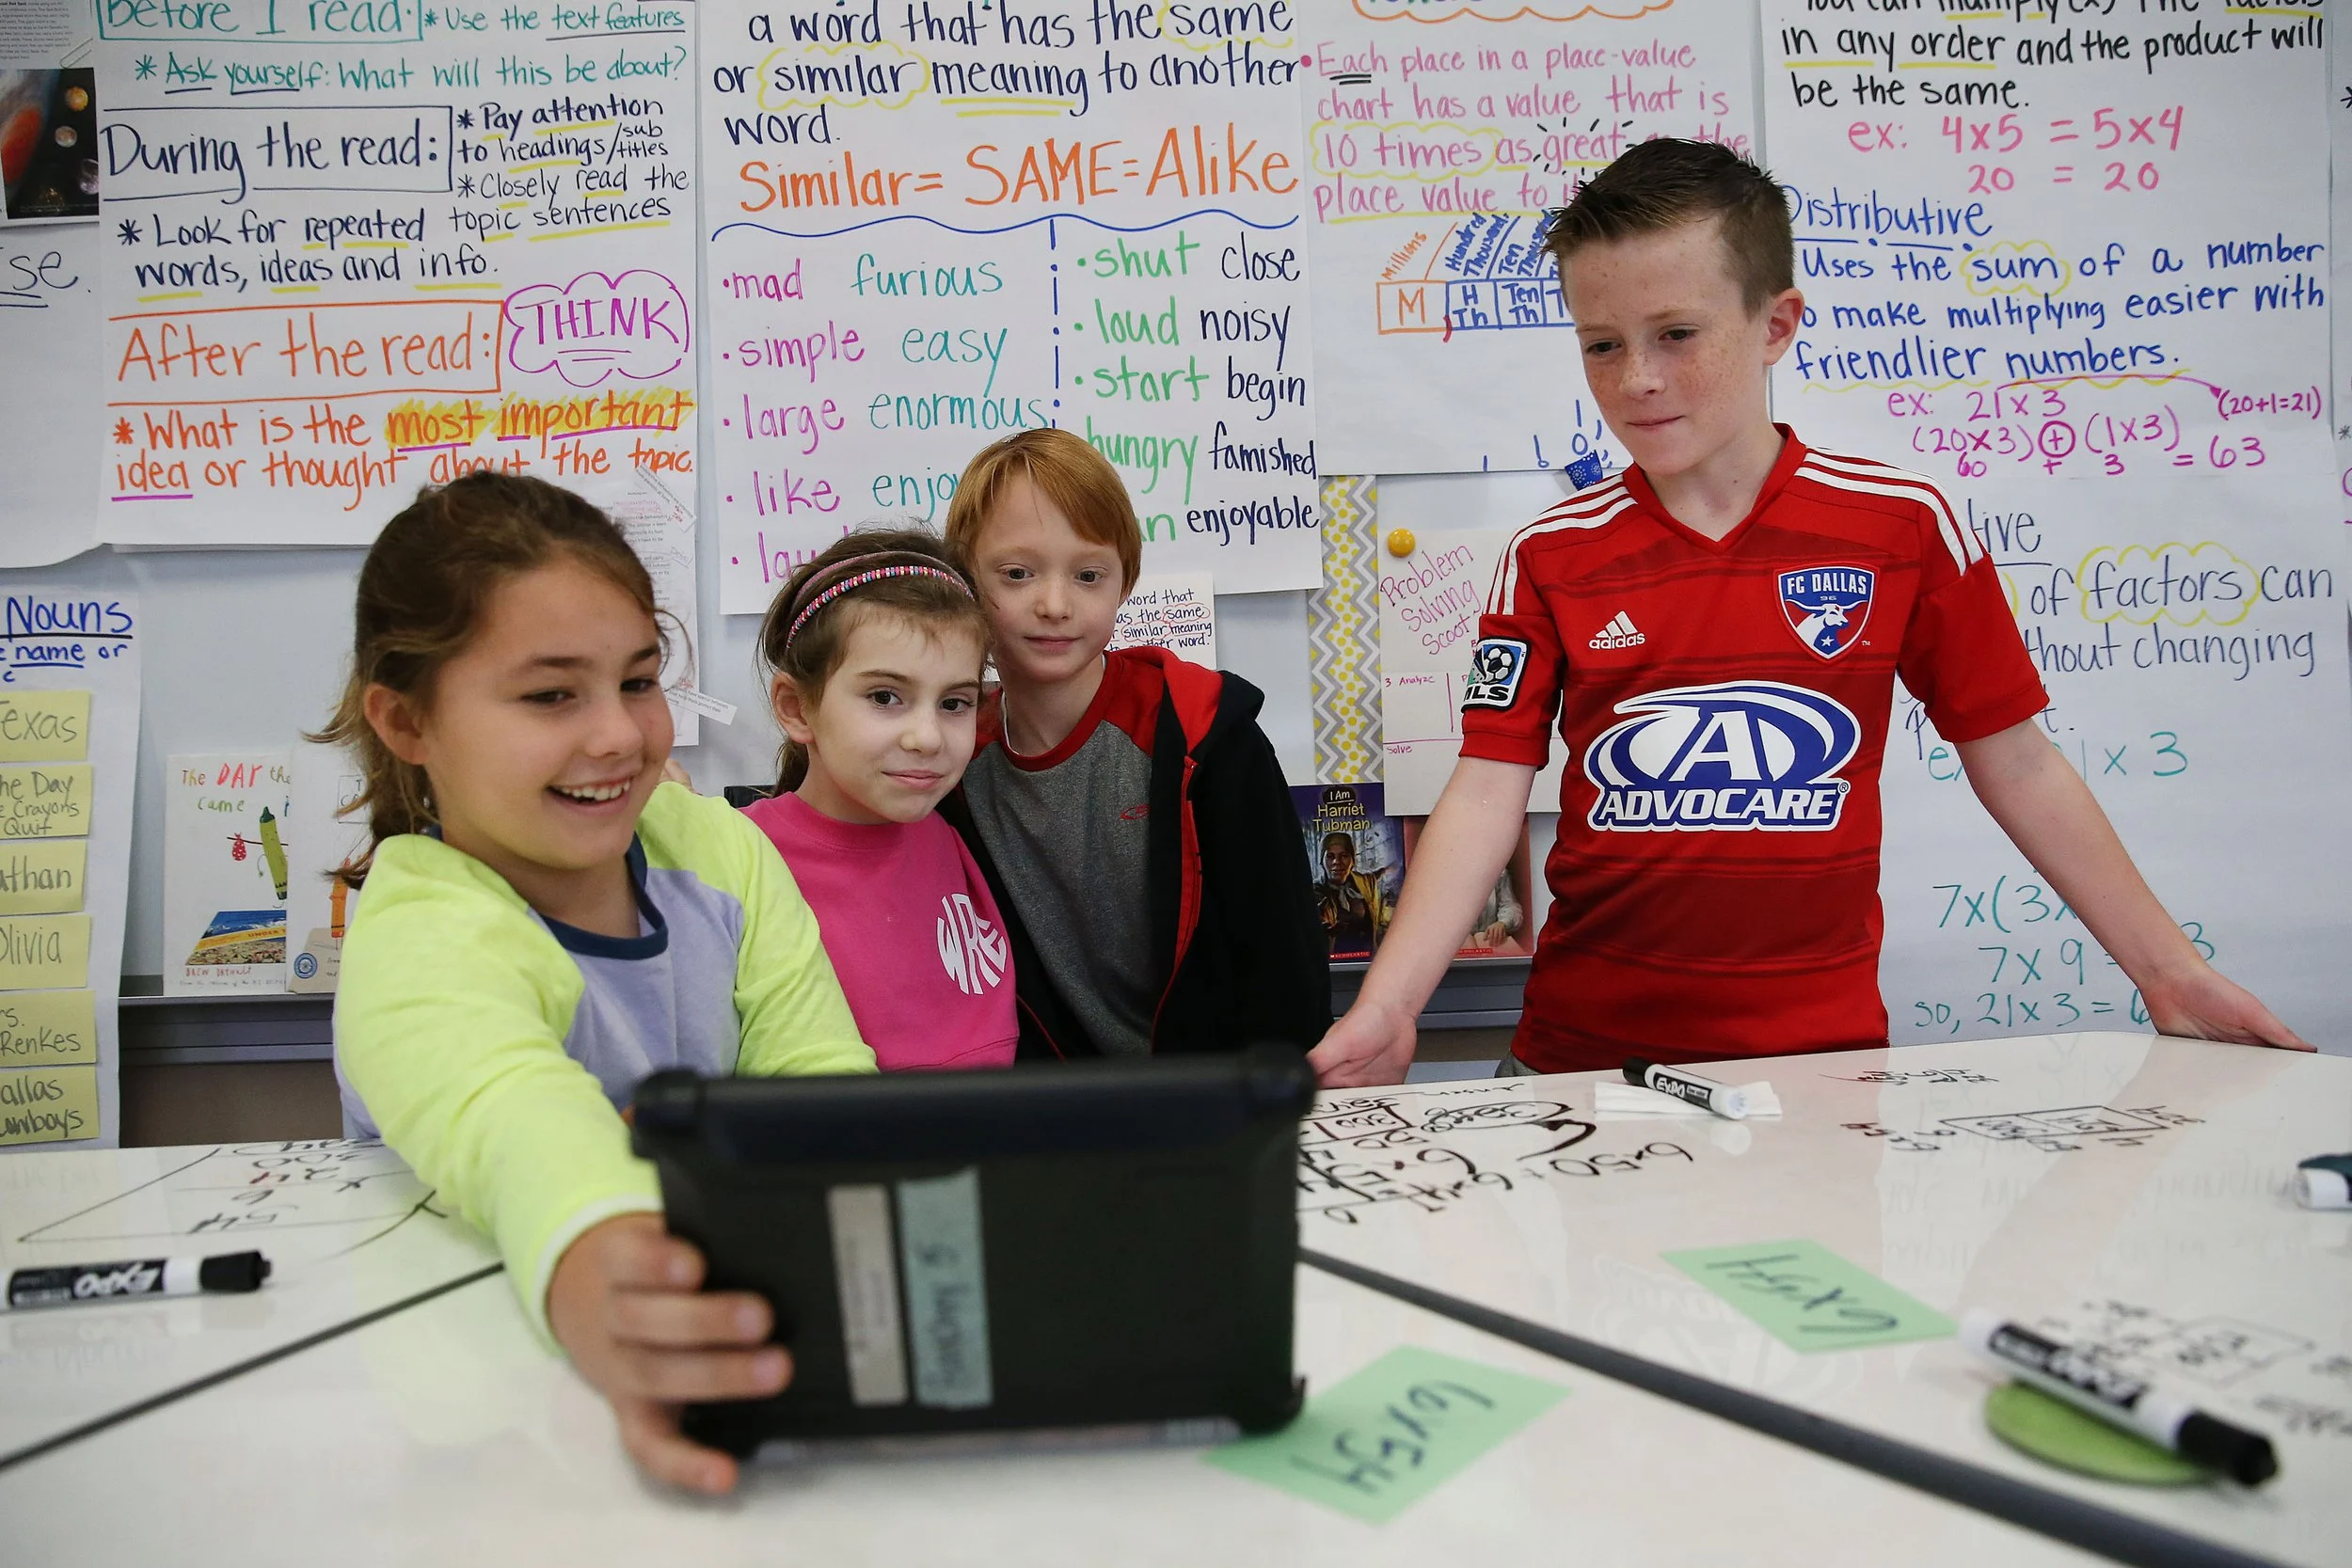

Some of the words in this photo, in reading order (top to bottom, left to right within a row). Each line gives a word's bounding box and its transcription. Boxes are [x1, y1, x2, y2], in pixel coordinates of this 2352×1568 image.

[445, 5, 487, 31] Use
[500, 7, 535, 29] the
[551, 4, 599, 28] text
[606, 2, 685, 28] features
[790, 3, 882, 44] word
[900, 2, 978, 43] that
[1000, 0, 1075, 48] has
[1162, 0, 1294, 40] same
[1317, 41, 1389, 77] Each
[1402, 46, 1465, 83] place
[1546, 39, 1696, 80] place-value
[1837, 29, 1895, 72] any
[1911, 25, 2006, 62] order
[2017, 27, 2074, 66] and
[2144, 15, 2263, 74] product
[2270, 17, 2324, 51] will
[166, 51, 213, 85] Ask
[231, 54, 330, 92] yourself:
[435, 53, 480, 87] will
[497, 54, 553, 86] this
[608, 46, 687, 81] about?
[774, 55, 919, 98] similar
[932, 58, 1089, 117] meaning
[1149, 42, 1302, 87] another
[1851, 73, 1905, 106] the
[1920, 81, 2030, 108] same.
[1318, 87, 1394, 121] chart
[1413, 83, 1466, 119] has
[1505, 84, 1581, 117] value
[1606, 73, 1683, 115] that
[484, 104, 523, 140] Pay
[533, 99, 663, 125] attention
[724, 110, 841, 148] word.
[1849, 123, 1907, 152] ex:
[103, 124, 246, 203] During
[264, 119, 329, 169] the
[341, 119, 438, 167] read:
[1323, 134, 1357, 168] 10
[1374, 135, 1482, 168] times
[1542, 124, 1628, 175] great
[481, 172, 559, 208] Closely
[576, 167, 628, 193] read
[644, 167, 690, 191] the
[1313, 173, 1405, 224] place
[1422, 176, 1500, 213] value
[1967, 164, 2014, 194] 20
[2104, 162, 2160, 191] 20
[153, 212, 230, 245] Look
[240, 212, 286, 245] for
[304, 209, 426, 251] repeated
[450, 204, 516, 237] topic
[530, 198, 671, 227] sentences
[136, 250, 246, 290] words,
[262, 250, 334, 284] ideas
[420, 248, 498, 277] info.
[730, 259, 804, 302] mad
[850, 253, 1004, 296] furious
[1094, 236, 1200, 279] shut
[1221, 231, 1300, 282] close
[1498, 244, 1524, 274] Ten
[1804, 248, 1874, 278] Uses
[1891, 245, 1952, 281] the
[1972, 256, 2058, 280] sum
[2207, 232, 2325, 265] number
[516, 297, 679, 344] THINK
[1398, 287, 1425, 326] M
[1462, 284, 1479, 306] H
[1502, 282, 1539, 306] Ten
[1453, 308, 1489, 329] Th
[1508, 305, 1539, 325] Th
[1835, 301, 1926, 330] make
[1948, 297, 2106, 334] multiplying
[2126, 284, 2238, 318] easier
[2255, 274, 2325, 313] with
[119, 324, 261, 382] After
[280, 312, 365, 376] the
[382, 313, 492, 373] read:
[1094, 296, 1180, 346] loud
[1200, 303, 1292, 372] noisy
[739, 320, 866, 383] simple
[901, 325, 1008, 398] easy
[1795, 341, 1986, 381] friendlier
[2006, 338, 2179, 379] numbers.
[1093, 355, 1211, 403] start
[1227, 355, 1307, 421] begin
[1887, 389, 1933, 419] ex:
[146, 412, 238, 451] What
[304, 406, 373, 446] the
[388, 404, 485, 445] most
[499, 390, 693, 459] important
[743, 394, 846, 455] large
[867, 390, 1049, 430] enormous
[1208, 420, 1317, 480] famished
[2209, 436, 2266, 469] 63
[115, 457, 191, 491] idea
[262, 451, 409, 510] thought
[753, 471, 841, 515] like
[1186, 496, 1319, 546] enjoyable
[1126, 591, 1157, 606] word
[1162, 588, 1195, 605] that
[1379, 544, 1474, 607] Problem
[1787, 575, 1805, 594] FC
[1811, 573, 1868, 594] DALLAS
[2031, 567, 2074, 616] of
[2090, 554, 2243, 609] factors
[2261, 565, 2332, 602] can
[7, 595, 133, 641] Nouns
[1137, 609, 1162, 624] the
[1167, 607, 1204, 619] same
[1401, 578, 1483, 632] Solving
[15, 643, 86, 660] name
[98, 645, 128, 658] or
[1123, 625, 1168, 639] similar
[1171, 622, 1212, 637] meaning
[1179, 633, 1210, 648] word.
[1422, 612, 1472, 656] Scoot
[1589, 631, 1645, 650] adidas
[2135, 623, 2315, 681] changing
[0, 701, 77, 742] exas
[31, 772, 73, 800] Day
[1335, 790, 1351, 800] Am
[1597, 787, 1840, 821] ADVOCARE
[1313, 818, 1371, 832] Tubman
[1317, 802, 1365, 817] Harriet
[1, 1076, 64, 1103] allas
